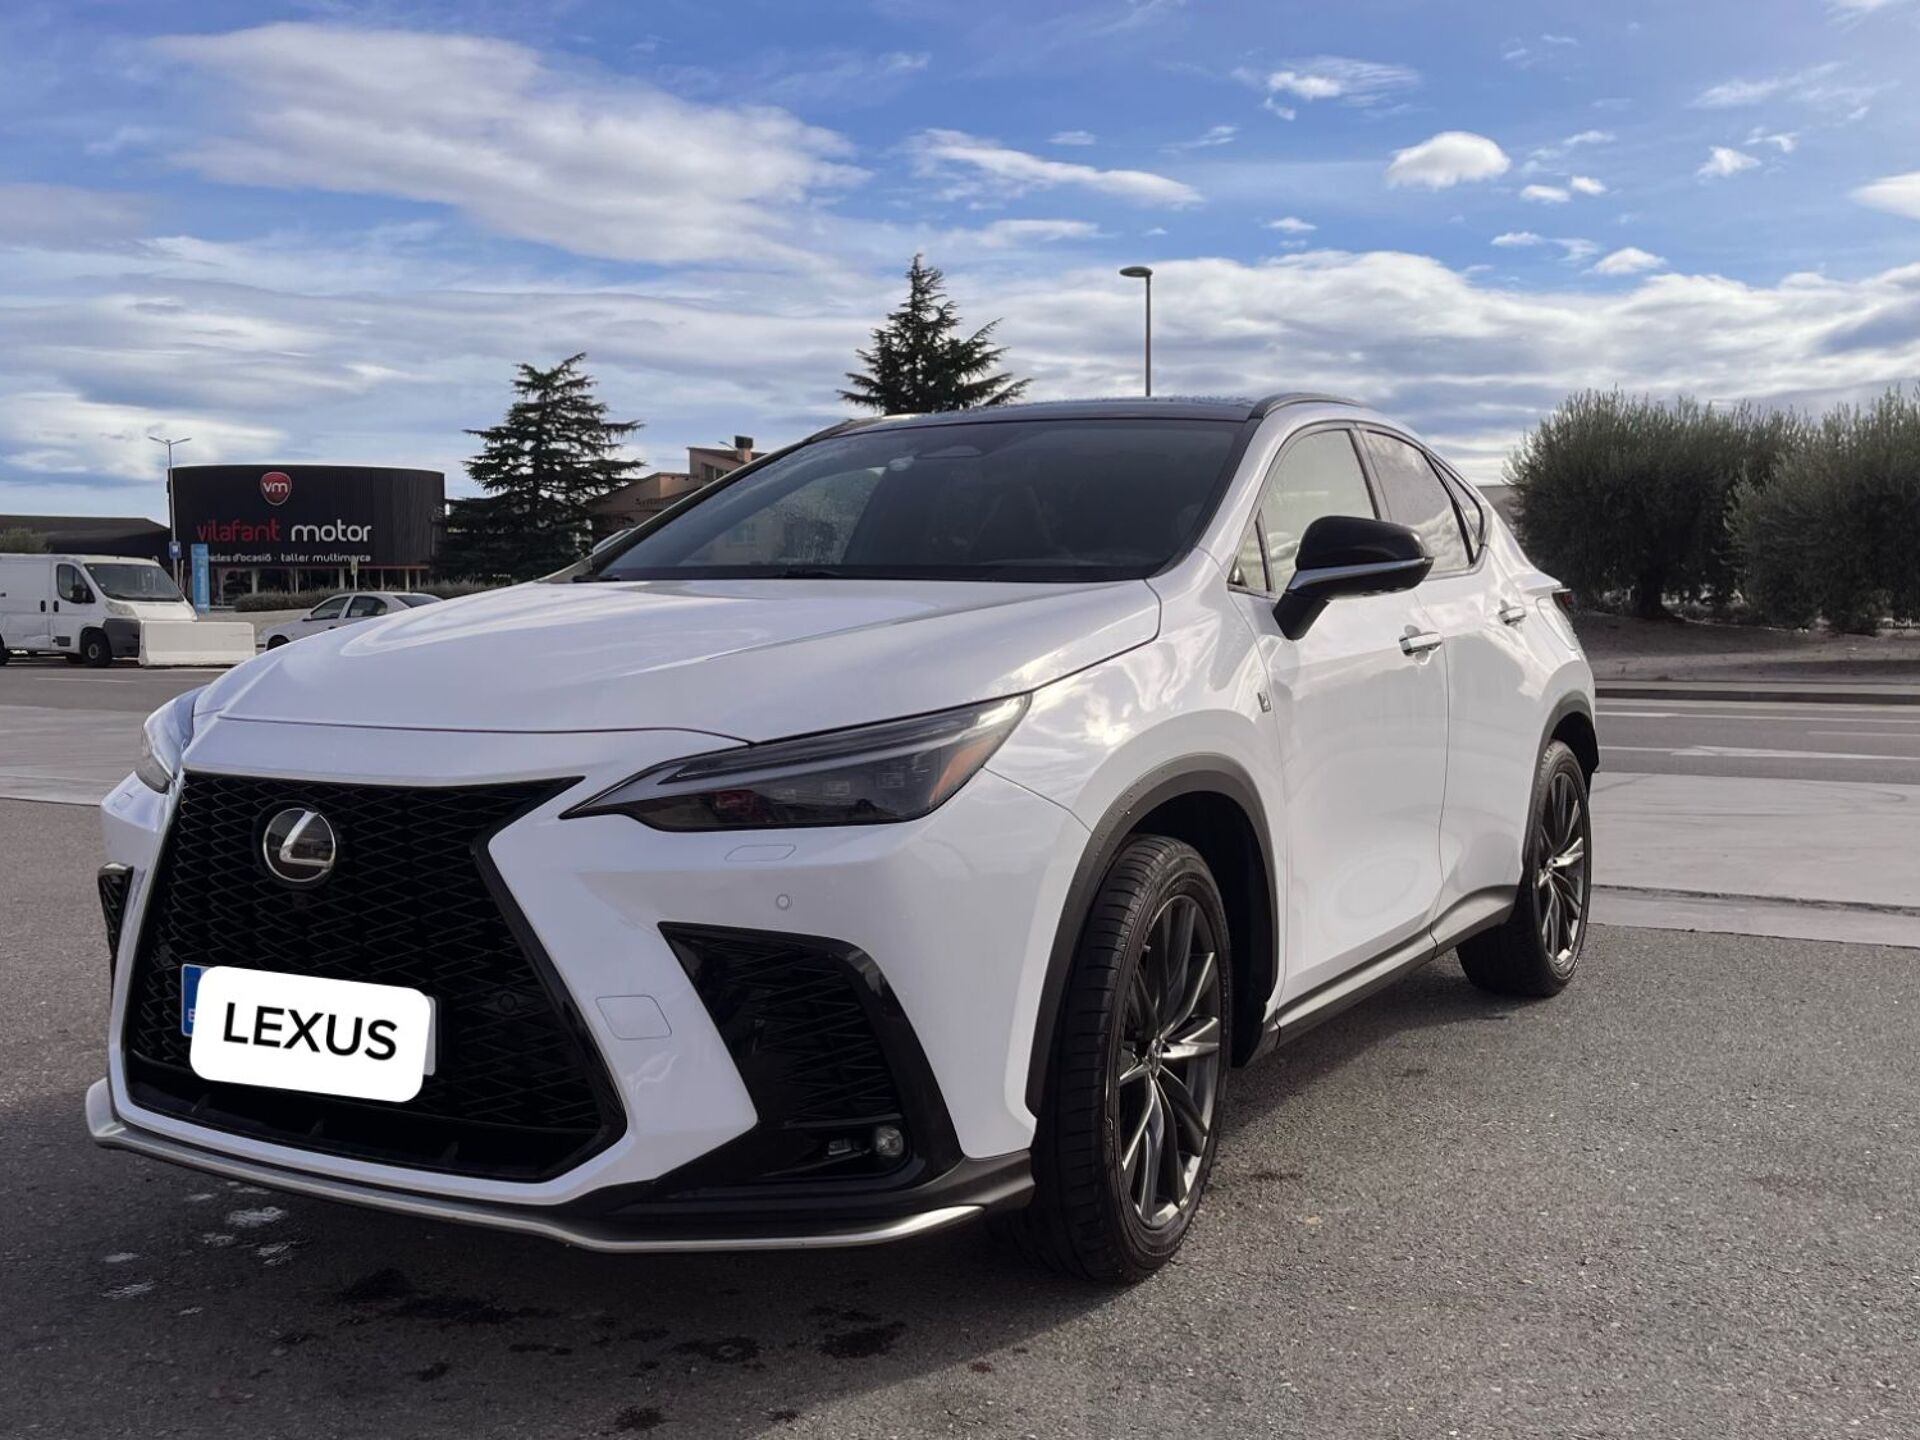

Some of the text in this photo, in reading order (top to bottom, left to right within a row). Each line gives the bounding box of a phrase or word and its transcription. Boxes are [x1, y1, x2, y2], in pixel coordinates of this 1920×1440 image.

[263, 482, 288, 493] vm
[197, 517, 372, 542] vilafant motor
[281, 552, 309, 562] taller
